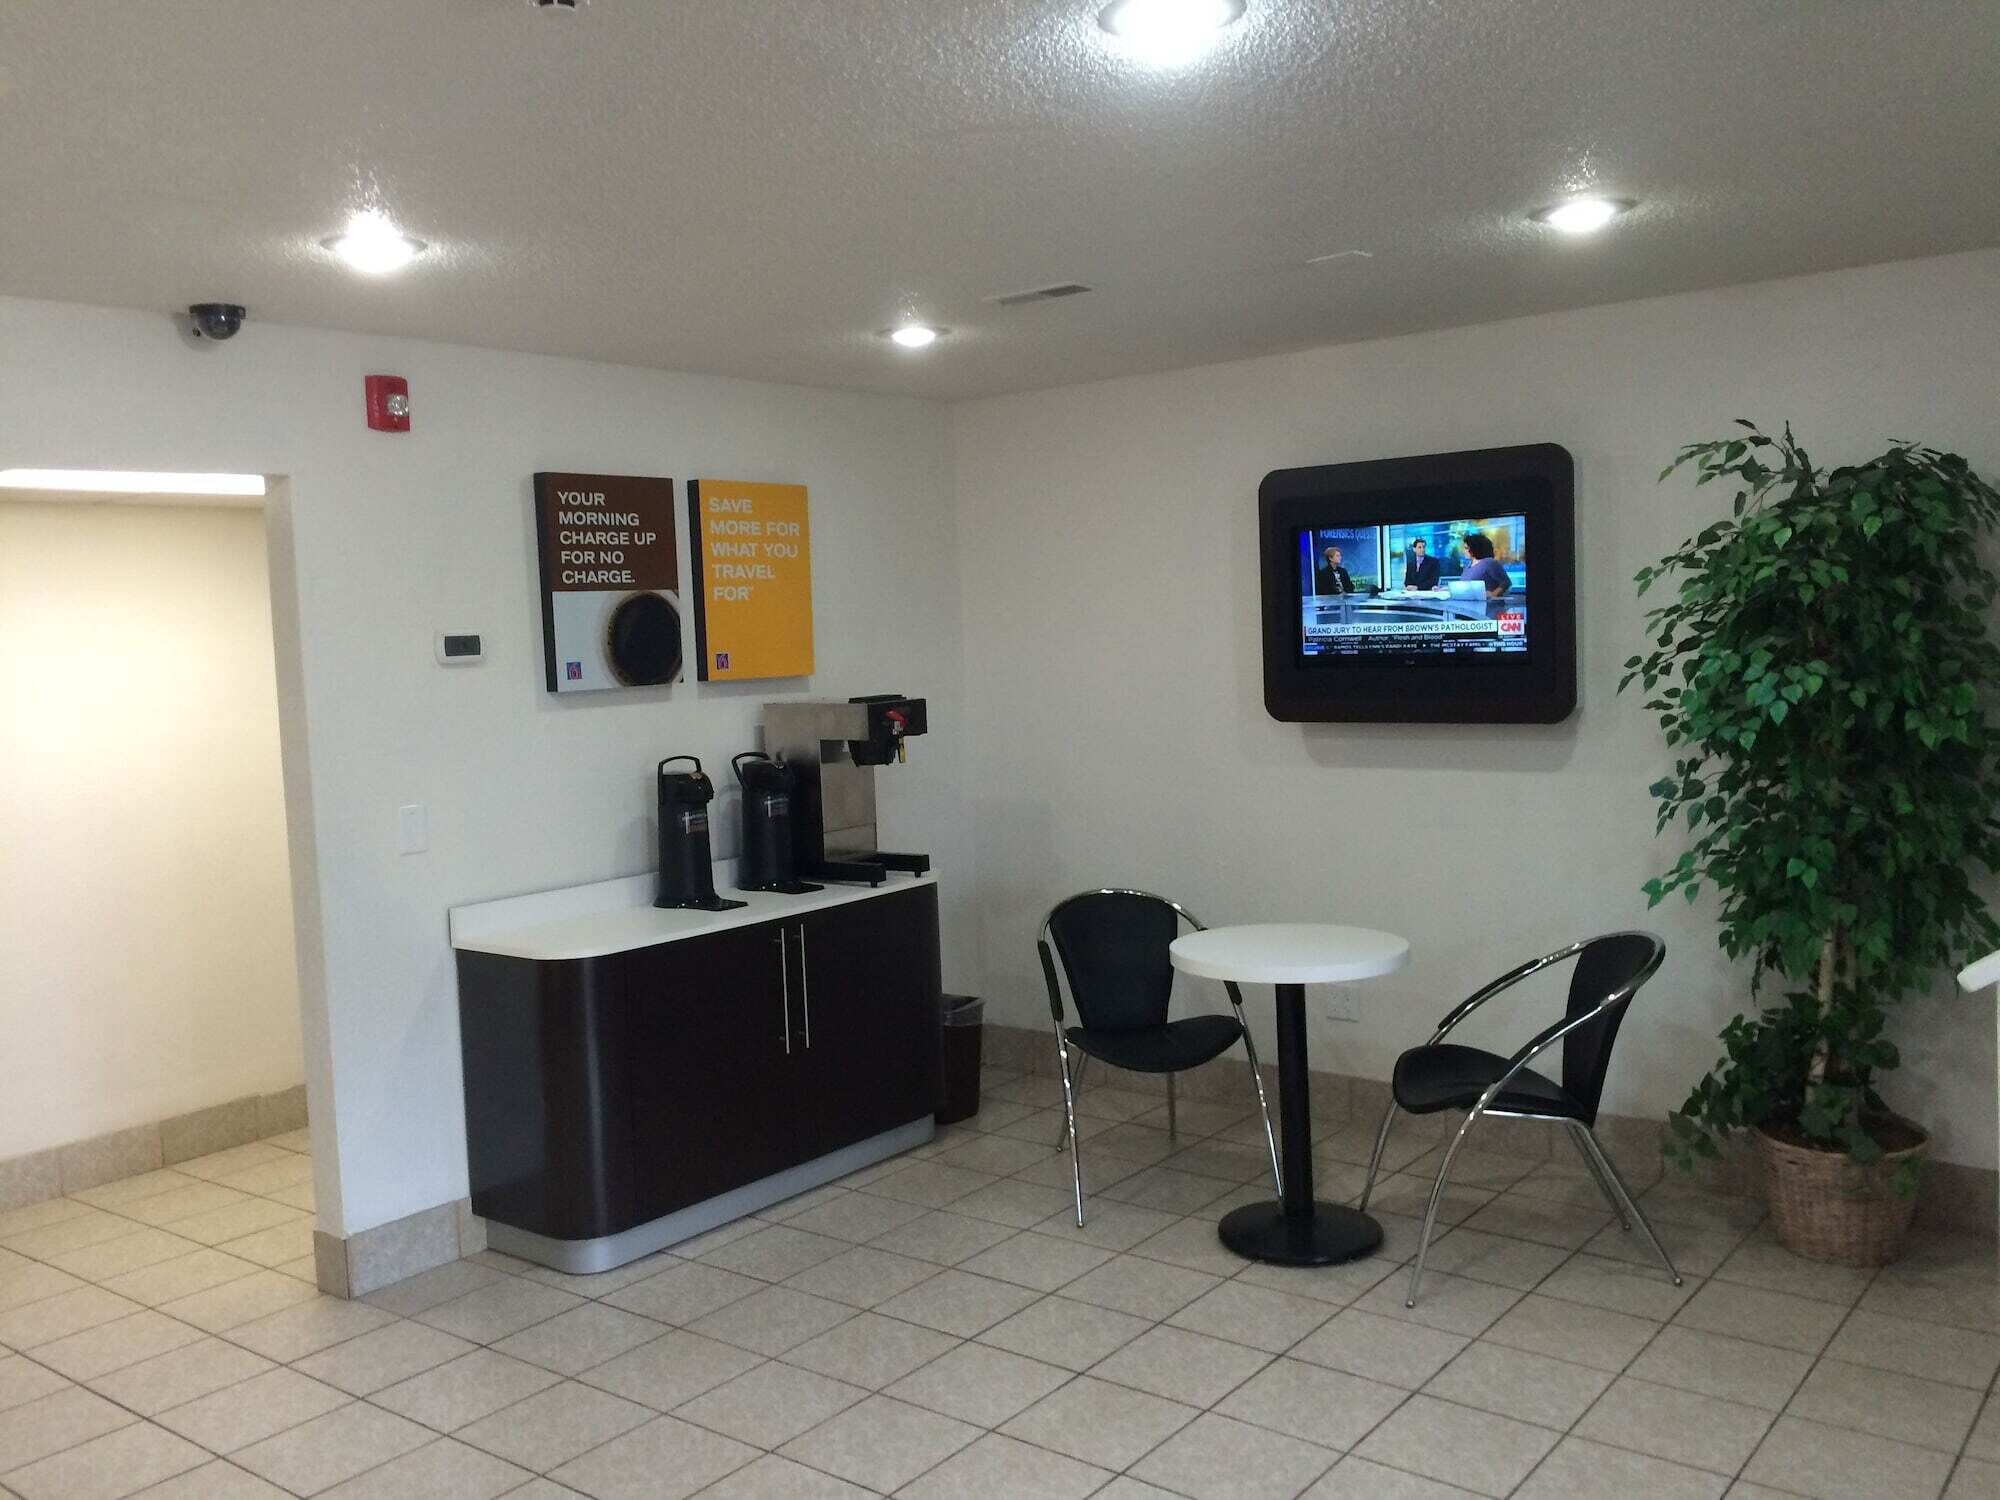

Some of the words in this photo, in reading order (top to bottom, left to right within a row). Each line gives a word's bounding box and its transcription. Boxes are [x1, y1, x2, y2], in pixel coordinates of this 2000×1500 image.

[557, 491, 606, 506] YOUR
[709, 497, 753, 514] SAVE
[558, 511, 641, 526] MORNING
[710, 519, 762, 536] MORE
[766, 521, 800, 537] FOR
[559, 530, 631, 545] CHARGE
[634, 531, 657, 546] UP
[561, 550, 596, 565] FOR
[599, 551, 625, 565] NO
[710, 542, 759, 558] WHAT
[763, 543, 799, 559] YOU
[562, 570, 636, 584] CHARGE.
[712, 564, 777, 580] TRAVEL
[1308, 626, 1332, 635] GRAND
[1333, 626, 1351, 634] JURY
[1352, 626, 1362, 634] TO
[1363, 625, 1382, 634] HEAR
[1383, 624, 1404, 633] FROM
[1405, 623, 1439, 633] BROWN'S
[1441, 622, 1494, 632] PATHOLOGIST
[1500, 622, 1521, 632] CNN
